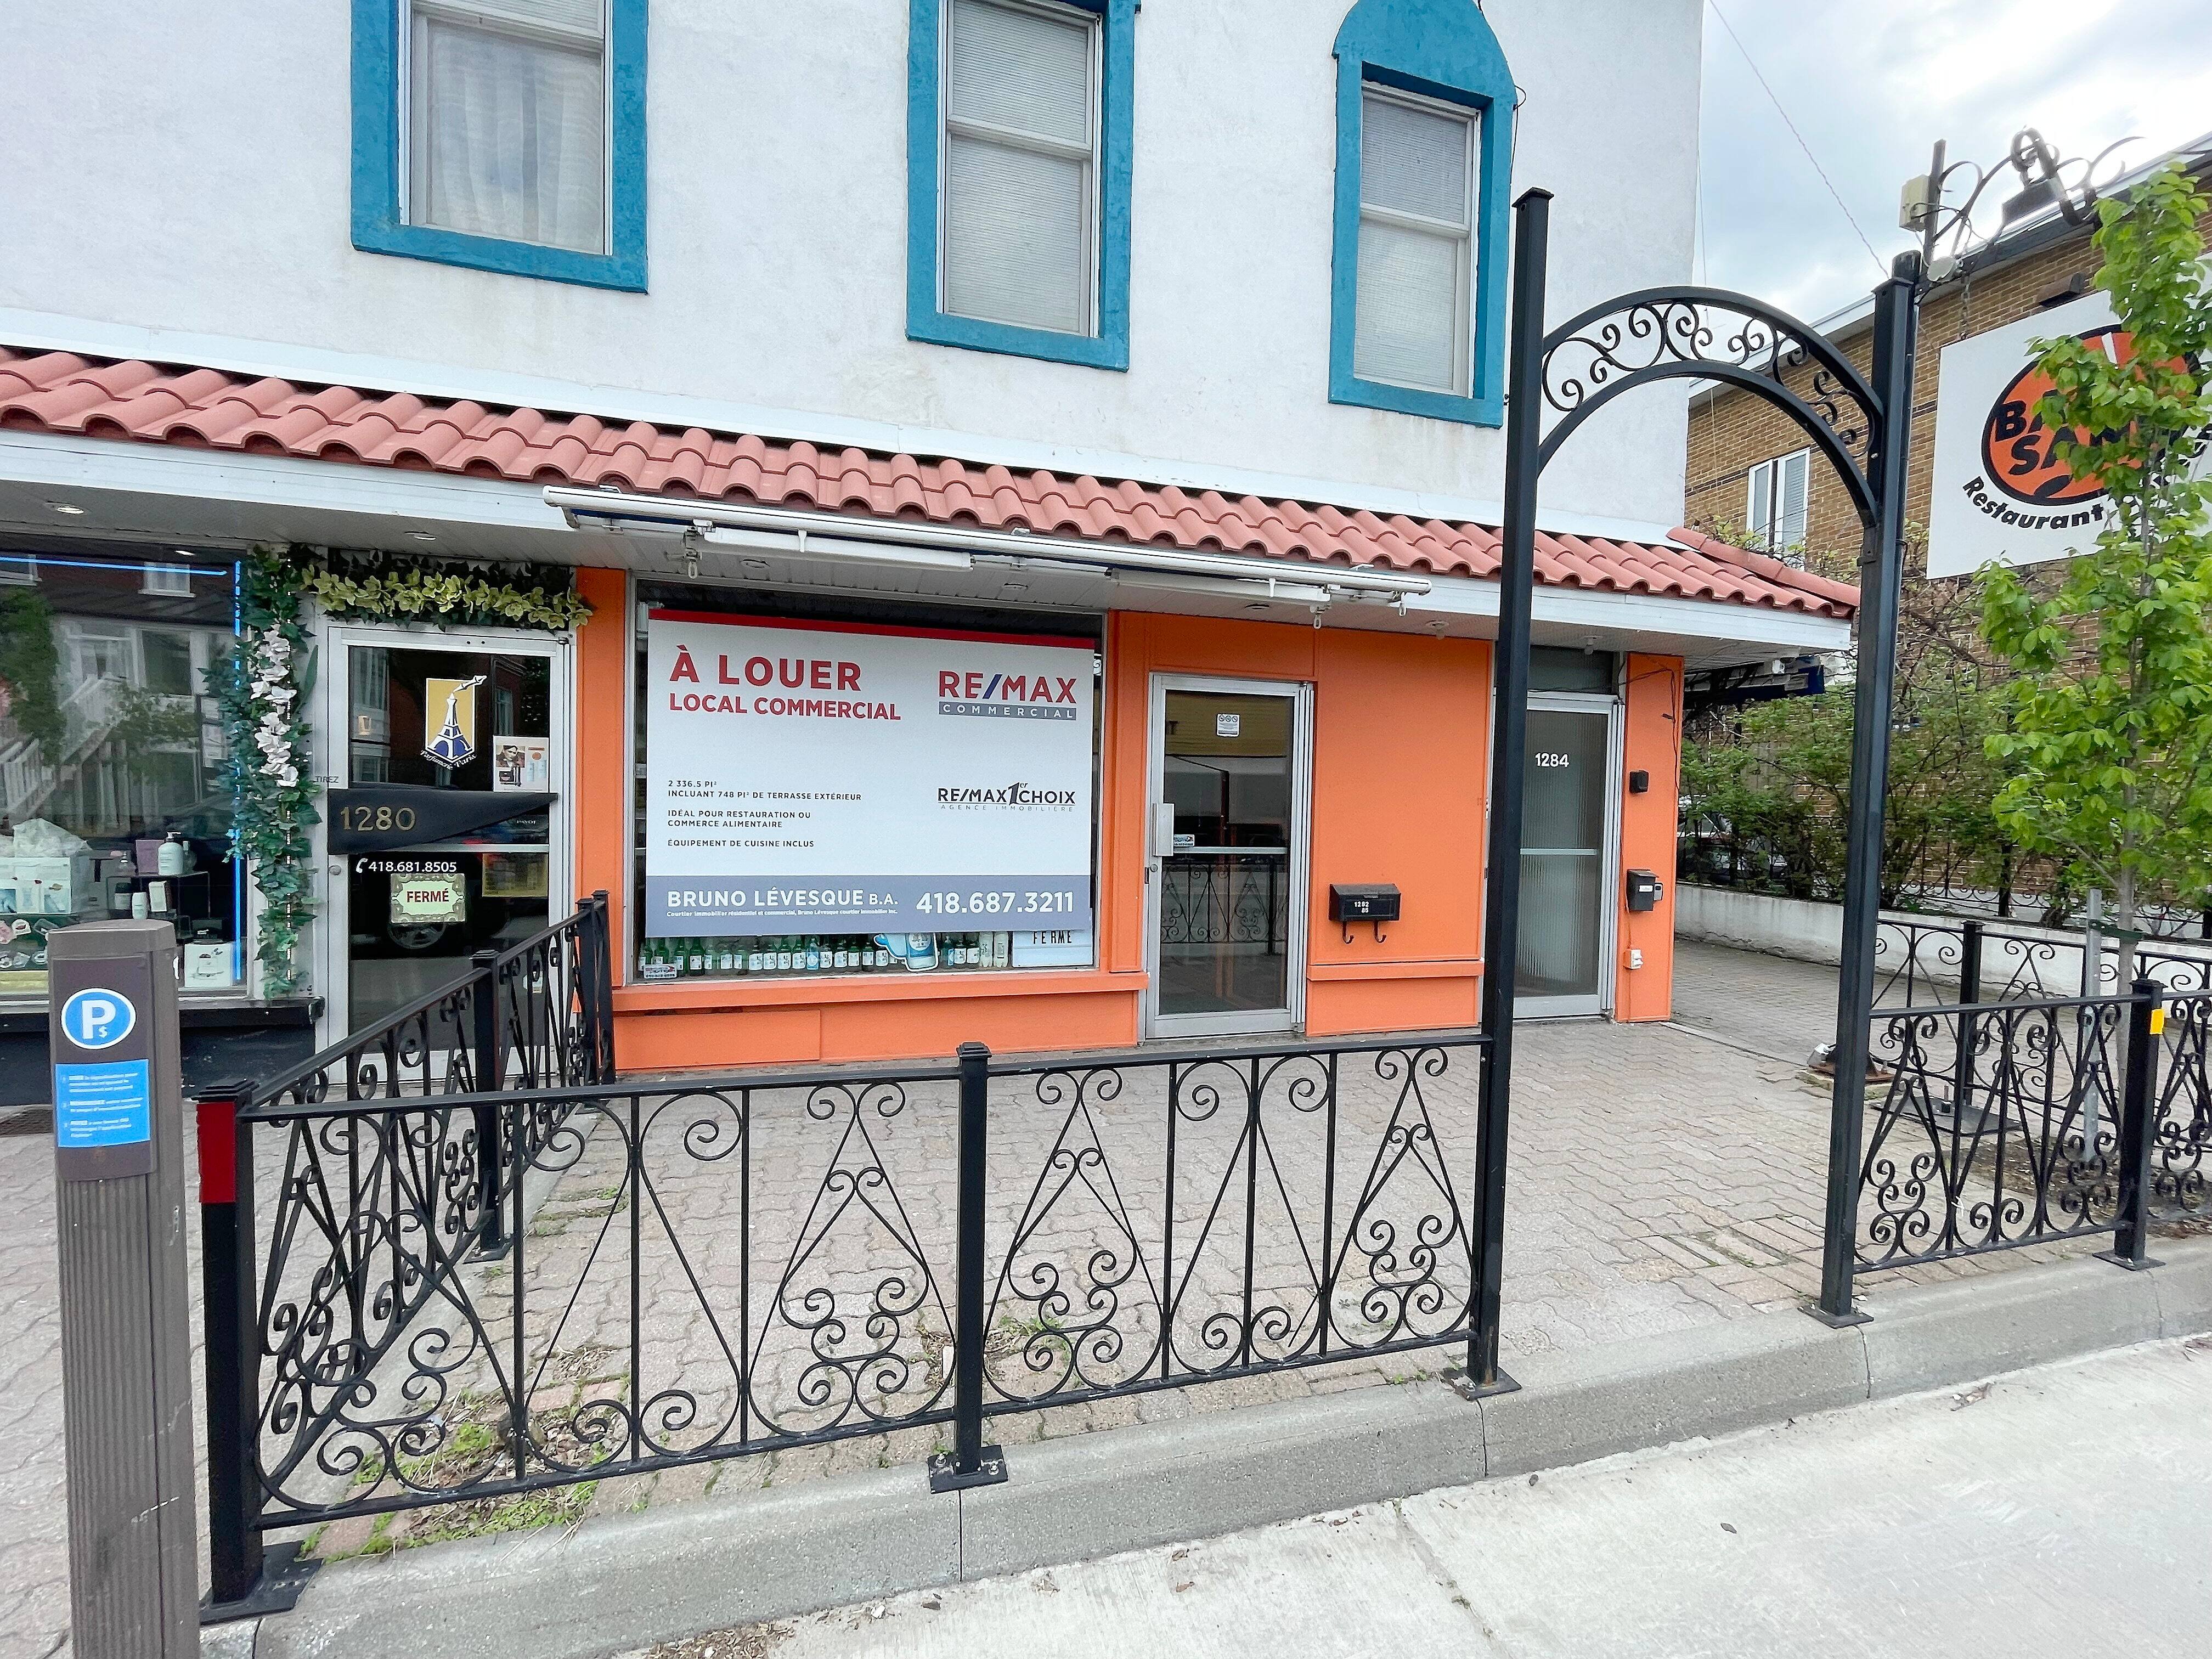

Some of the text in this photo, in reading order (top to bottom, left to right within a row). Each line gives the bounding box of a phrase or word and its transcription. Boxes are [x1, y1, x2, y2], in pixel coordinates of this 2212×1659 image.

[1963, 476, 2103, 529] Restaurant
[670, 644, 861, 691] À LOUER
[939, 670, 1076, 704] RE/MAX
[670, 693, 901, 720] LOCAL COMMERCIAL
[943, 704, 1073, 719] COMMERCIAL
[1536, 753, 1569, 767] 1284
[938, 788, 1007, 803] RE/MAX
[1018, 791, 1075, 804] CHOIX
[341, 807, 415, 831] 1280
[368, 861, 456, 872] 418.681.8505
[407, 888, 449, 902] FERMÉ
[668, 887, 898, 907] BRUNO LÉVESQUE B.A.
[916, 891, 1073, 913] 418.687.3211
